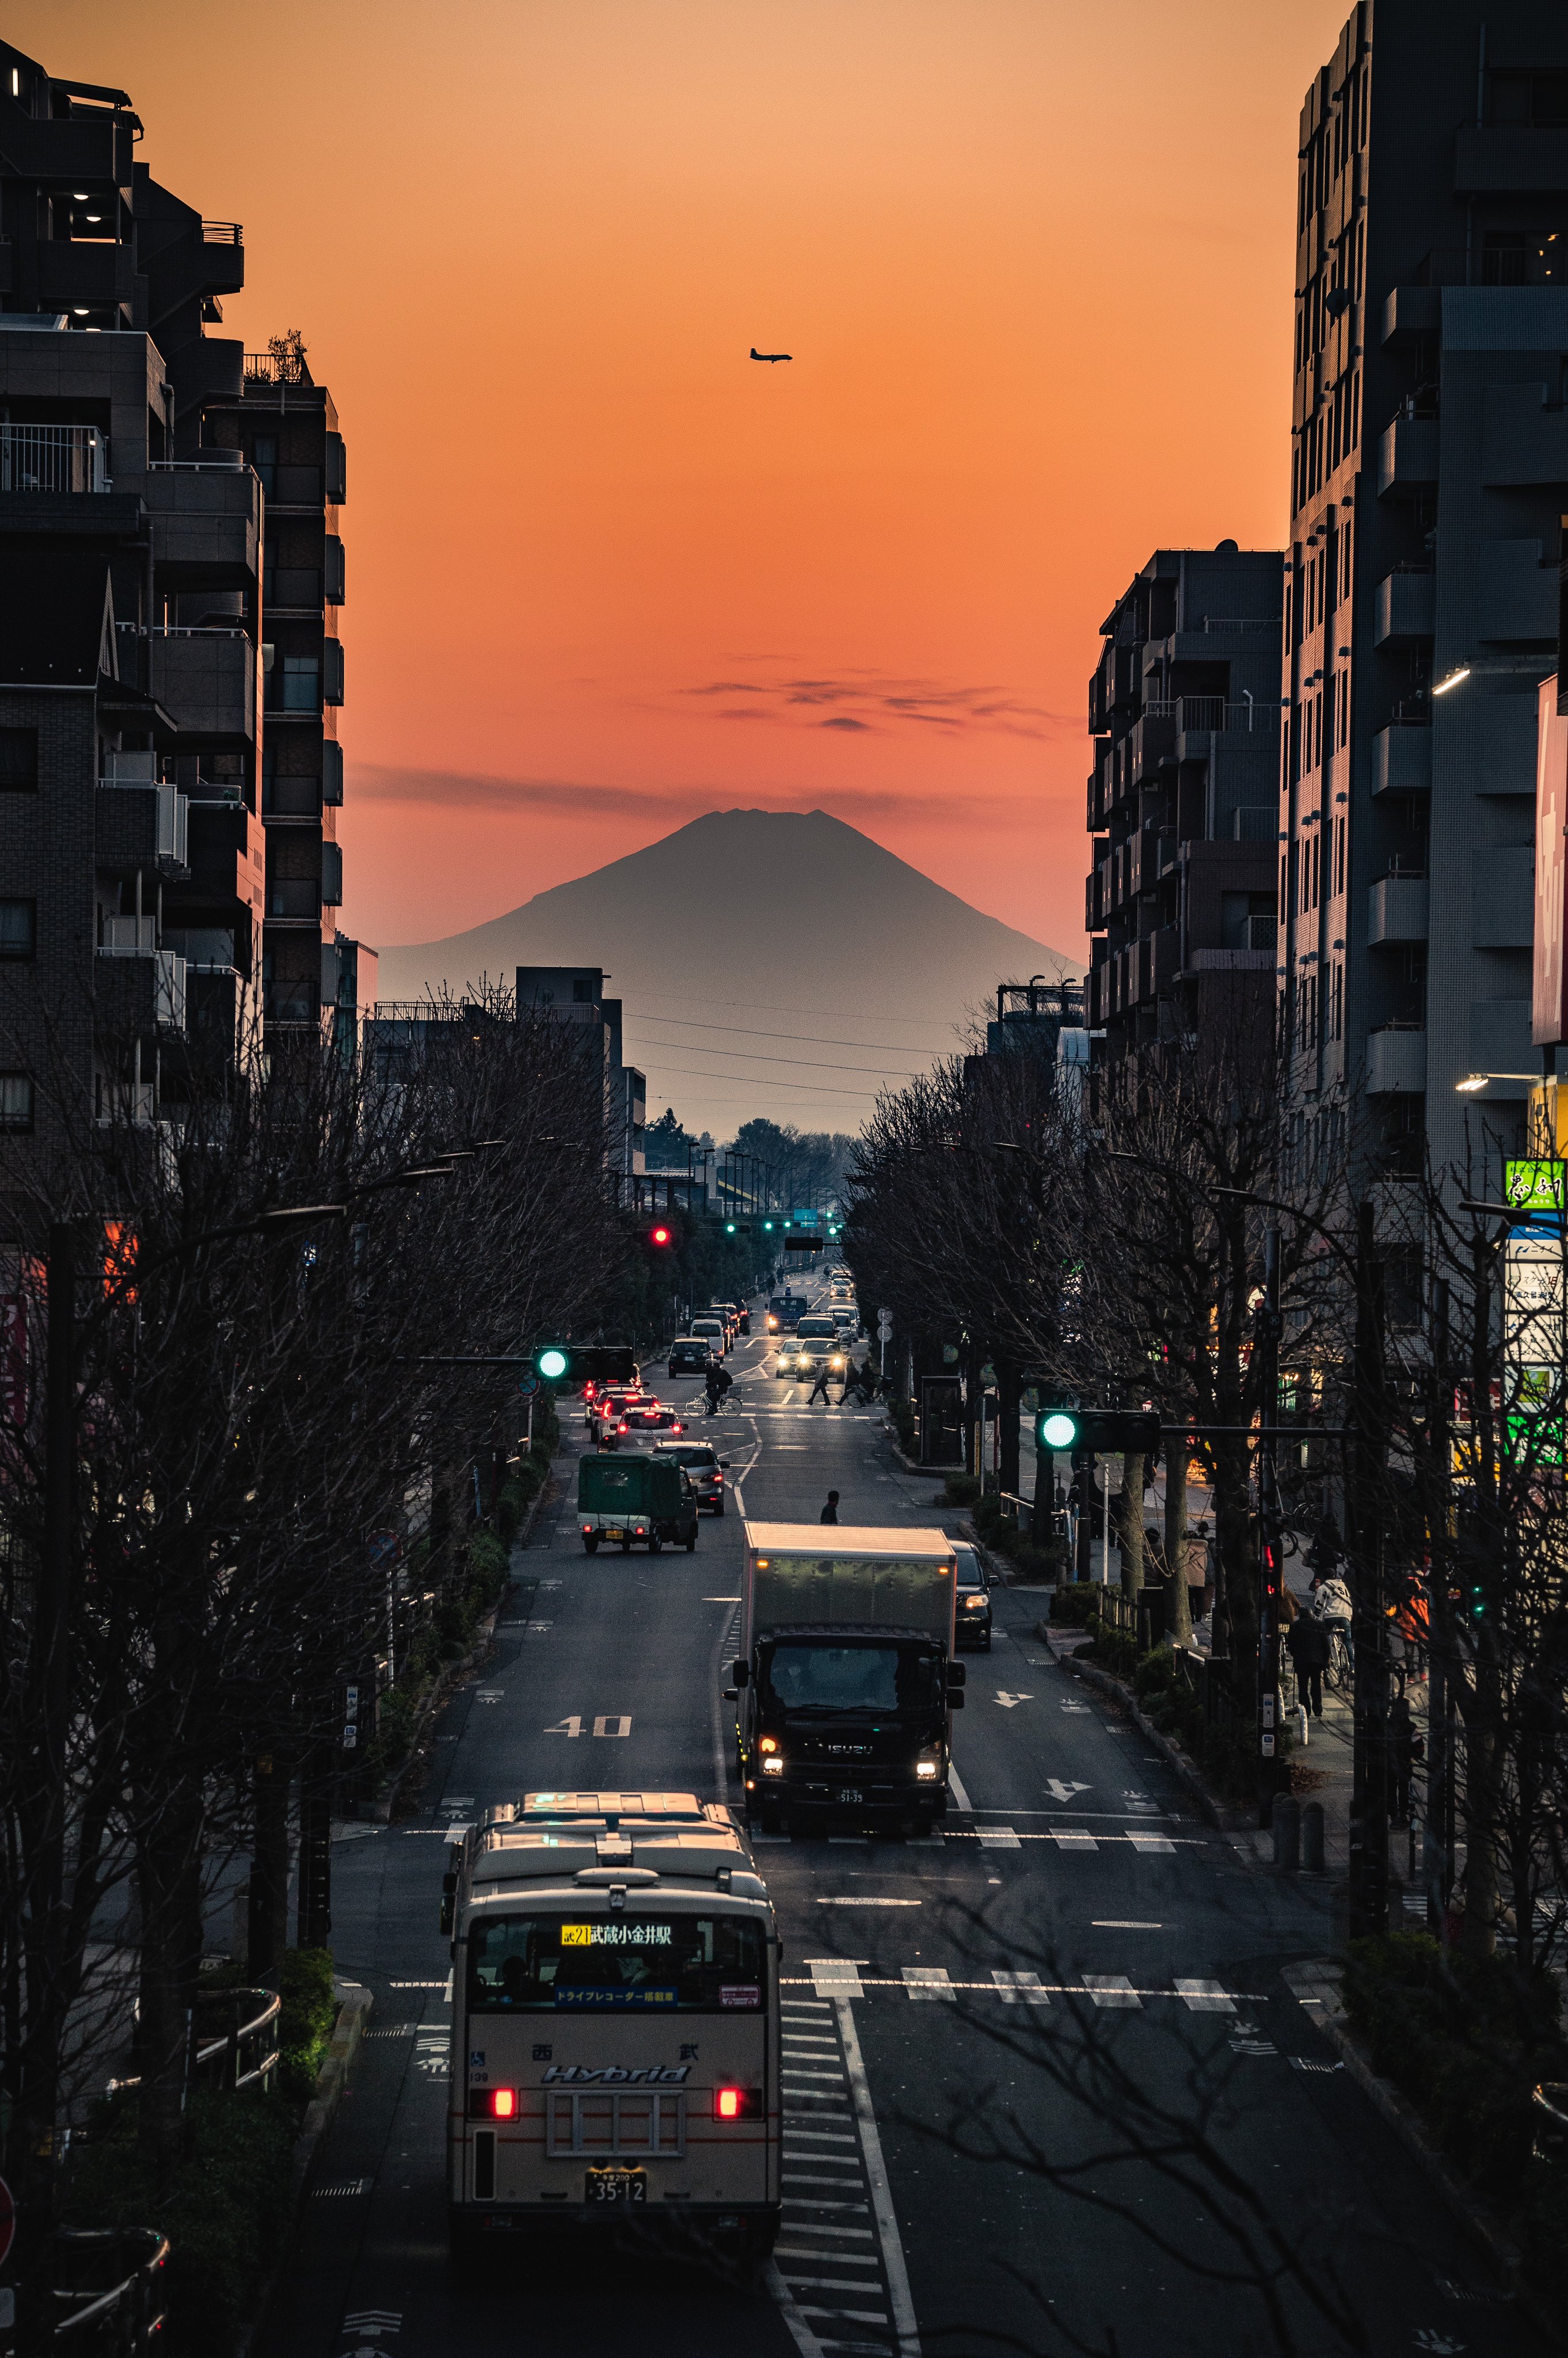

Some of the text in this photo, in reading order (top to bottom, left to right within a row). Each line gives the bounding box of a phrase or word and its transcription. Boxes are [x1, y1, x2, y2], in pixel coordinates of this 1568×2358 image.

[543, 1716, 632, 1737] 40
[828, 1745, 873, 1754] ISUZU
[591, 1925, 672, 1945] 武蔵小金井駅
[532, 2043, 699, 2061] 西 武
[541, 2065, 691, 2083] Hybrid
